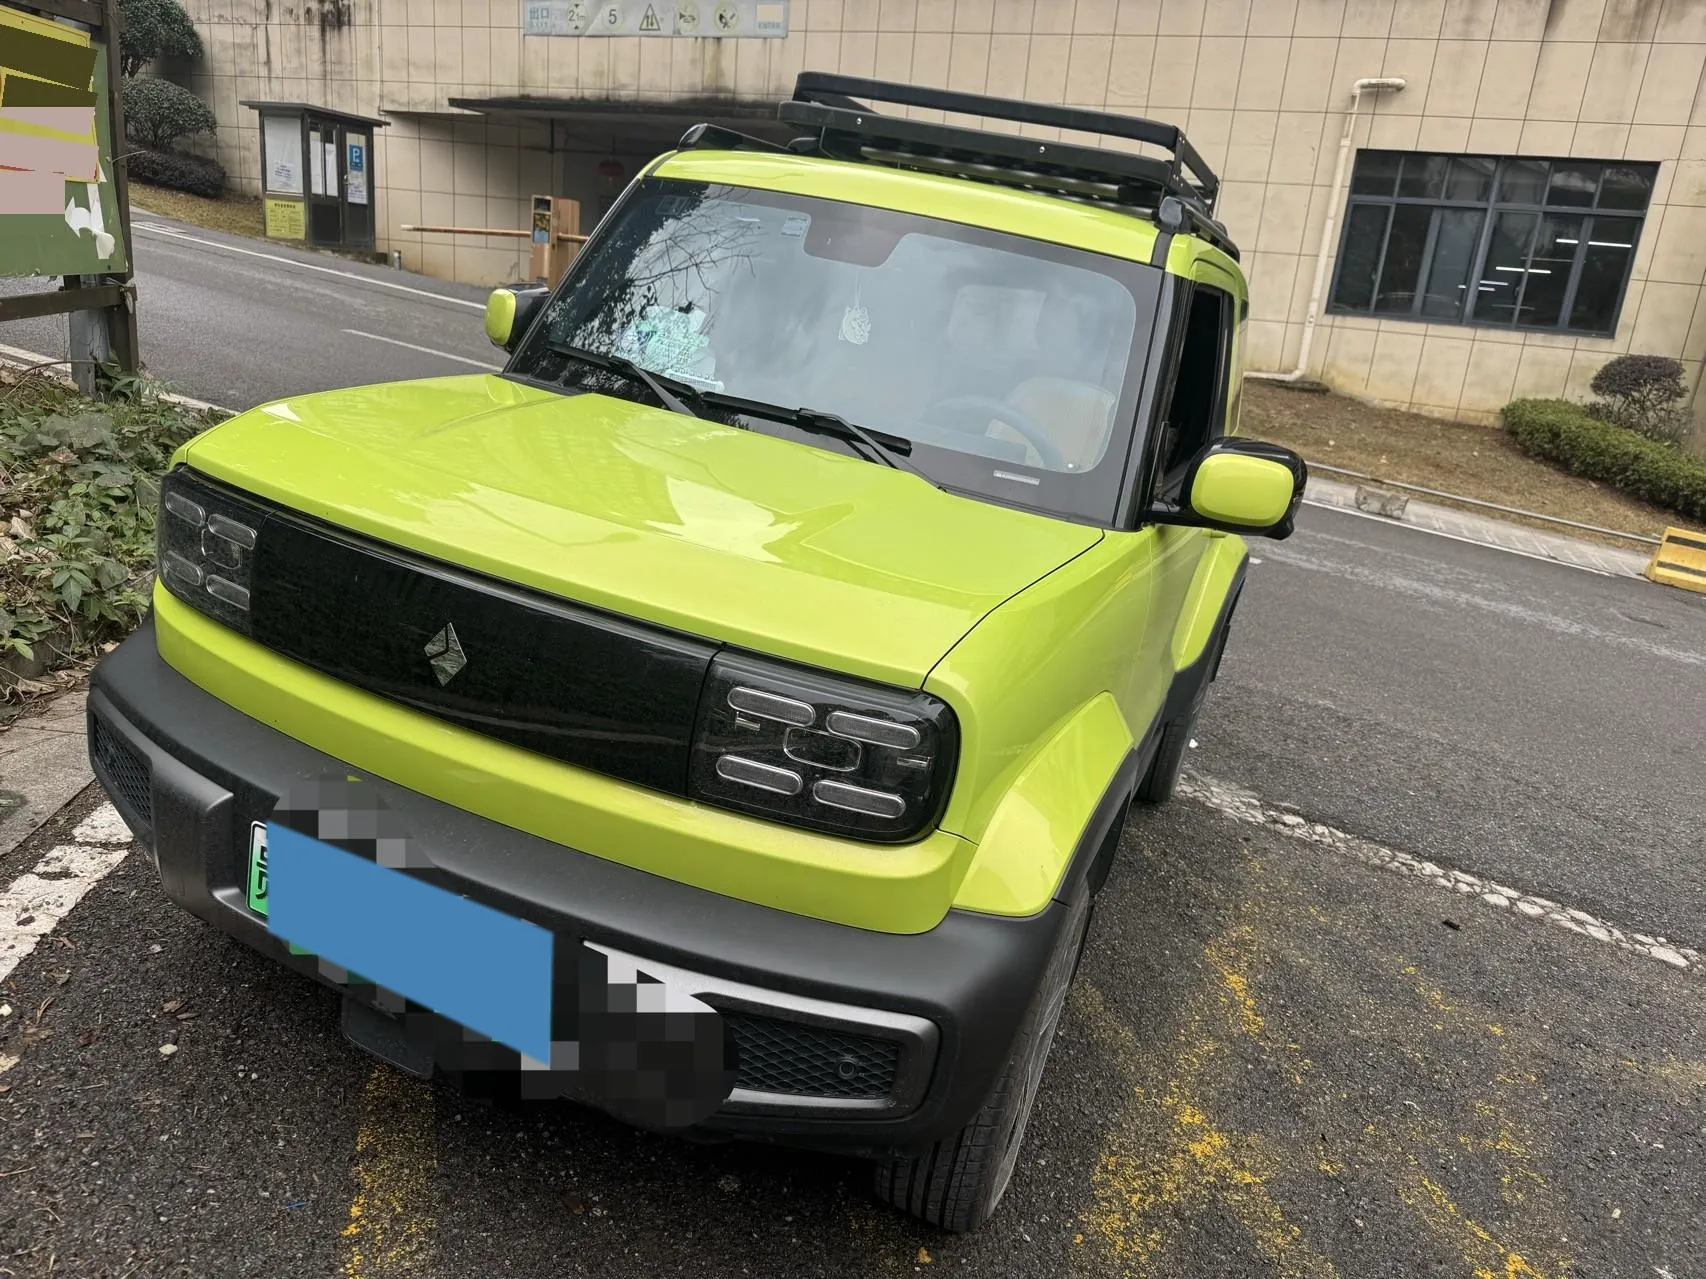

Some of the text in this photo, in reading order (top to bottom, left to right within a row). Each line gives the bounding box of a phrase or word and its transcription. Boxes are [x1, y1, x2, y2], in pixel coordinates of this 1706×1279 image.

[530, 7, 549, 19] 出口
[608, 8, 617, 24] 5
[353, 148, 360, 162] P
